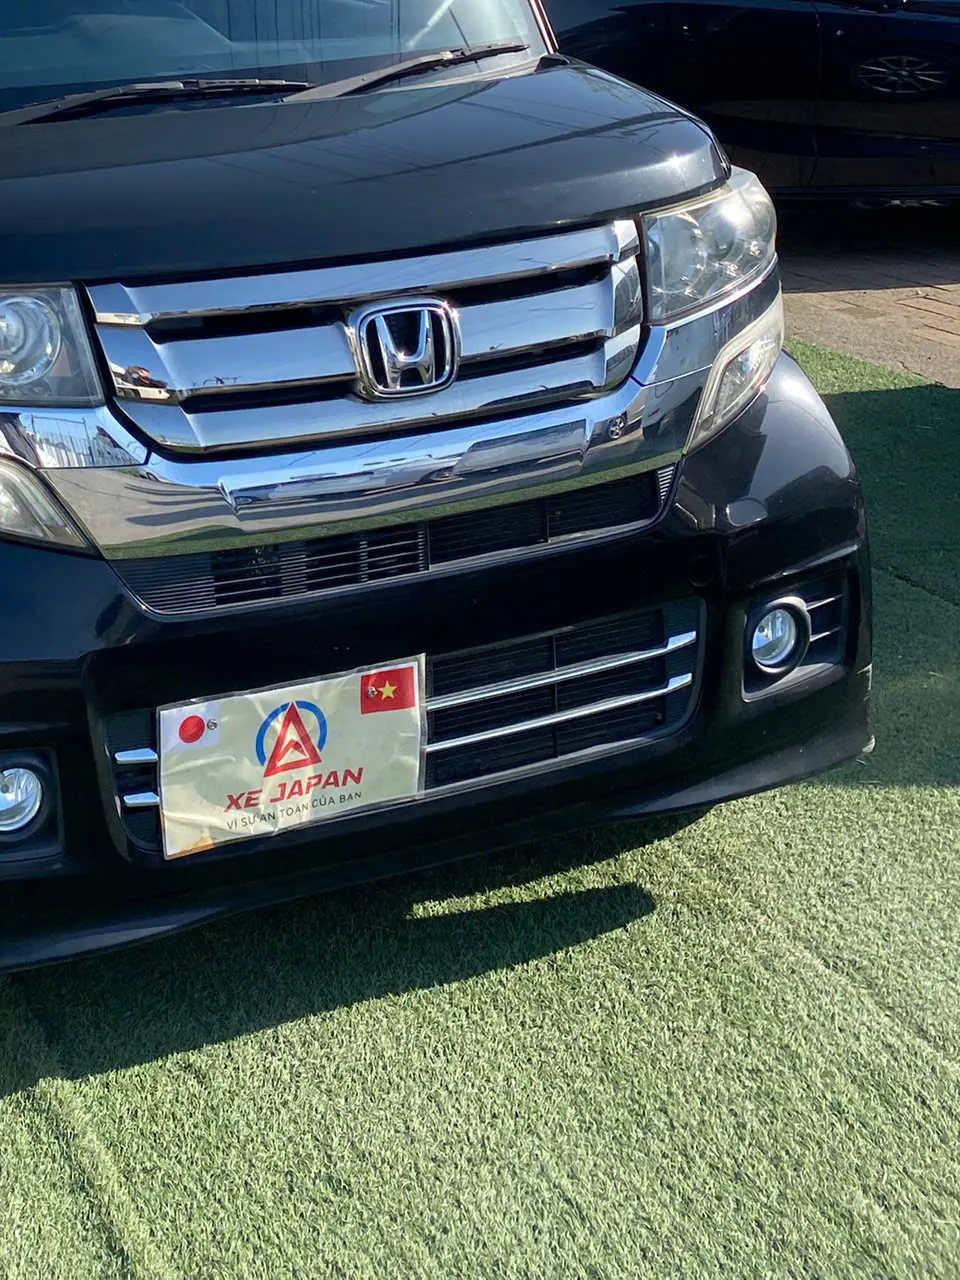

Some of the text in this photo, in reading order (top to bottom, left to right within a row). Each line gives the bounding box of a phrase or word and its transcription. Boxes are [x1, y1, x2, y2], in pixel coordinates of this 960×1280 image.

[224, 767, 364, 813] XE JAPAN
[260, 811, 276, 823] AN
